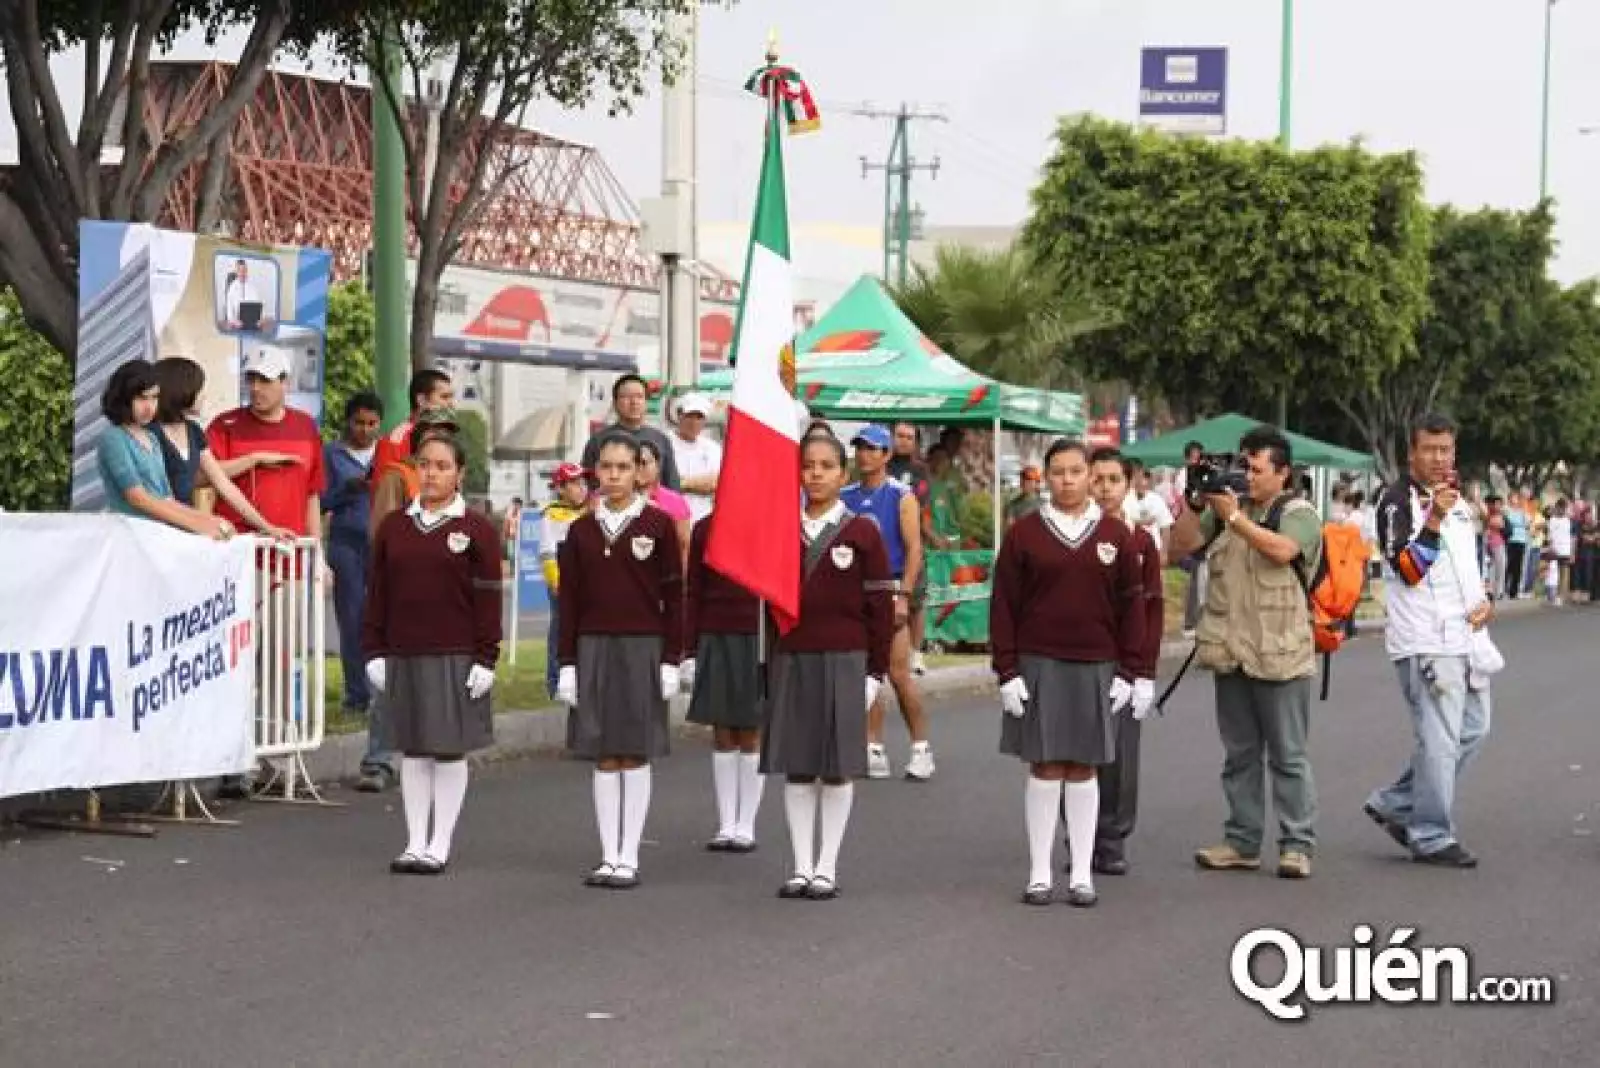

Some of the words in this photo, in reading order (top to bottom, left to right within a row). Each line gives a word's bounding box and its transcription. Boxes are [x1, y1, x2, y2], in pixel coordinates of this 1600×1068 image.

[127, 620, 153, 668] La
[162, 577, 236, 650] mezcla
[132, 640, 226, 732] perfecta
